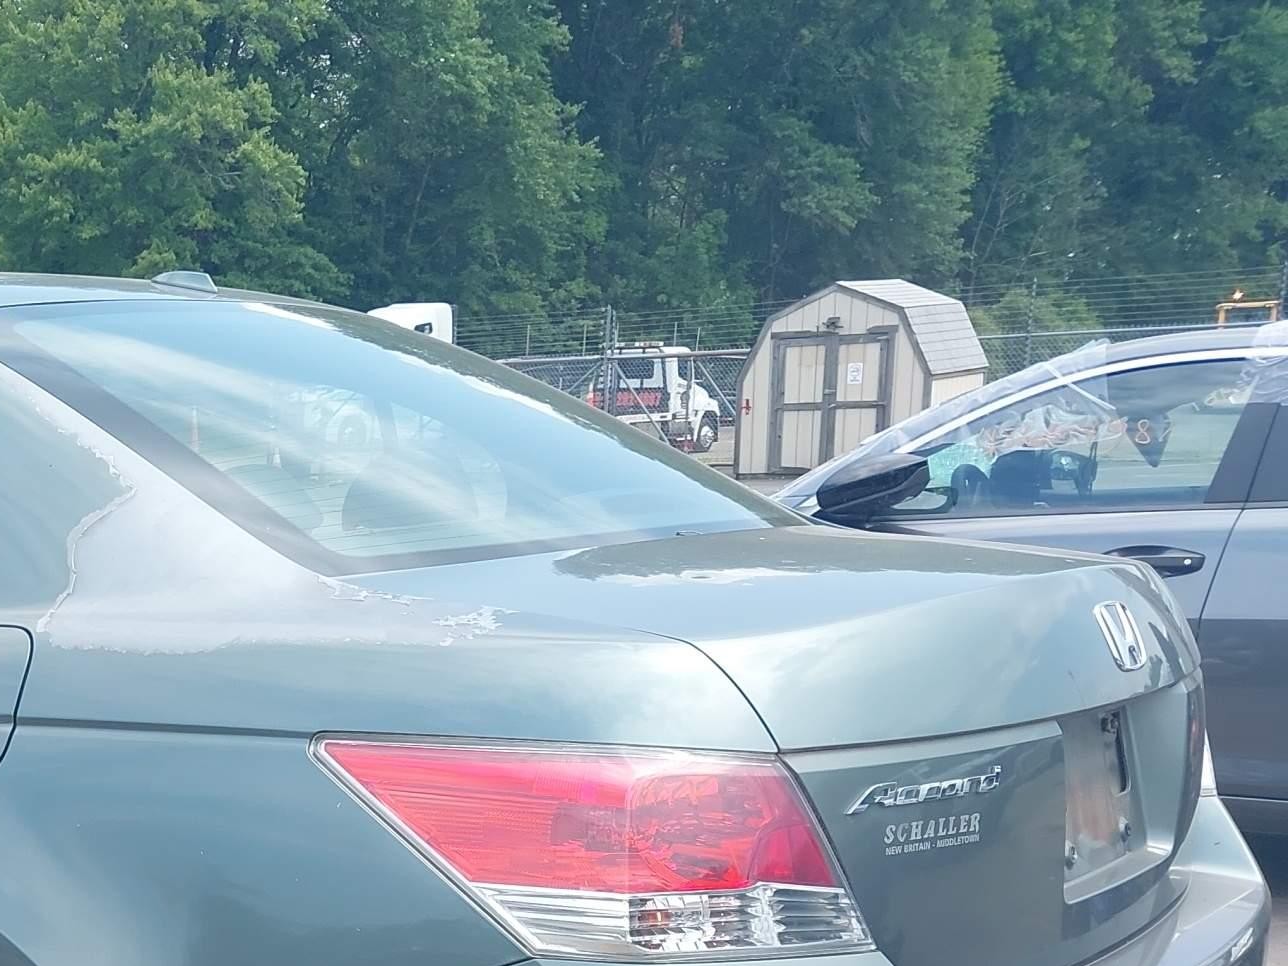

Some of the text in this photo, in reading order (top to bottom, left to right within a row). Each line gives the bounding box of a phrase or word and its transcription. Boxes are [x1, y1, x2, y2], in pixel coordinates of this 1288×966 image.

[844, 765, 1002, 815] Accord
[883, 813, 981, 845] SCHALLER
[885, 846, 903, 856] NEW
[904, 842, 931, 853] BRITAIN
[937, 835, 981, 849] MIDDLETOWN
